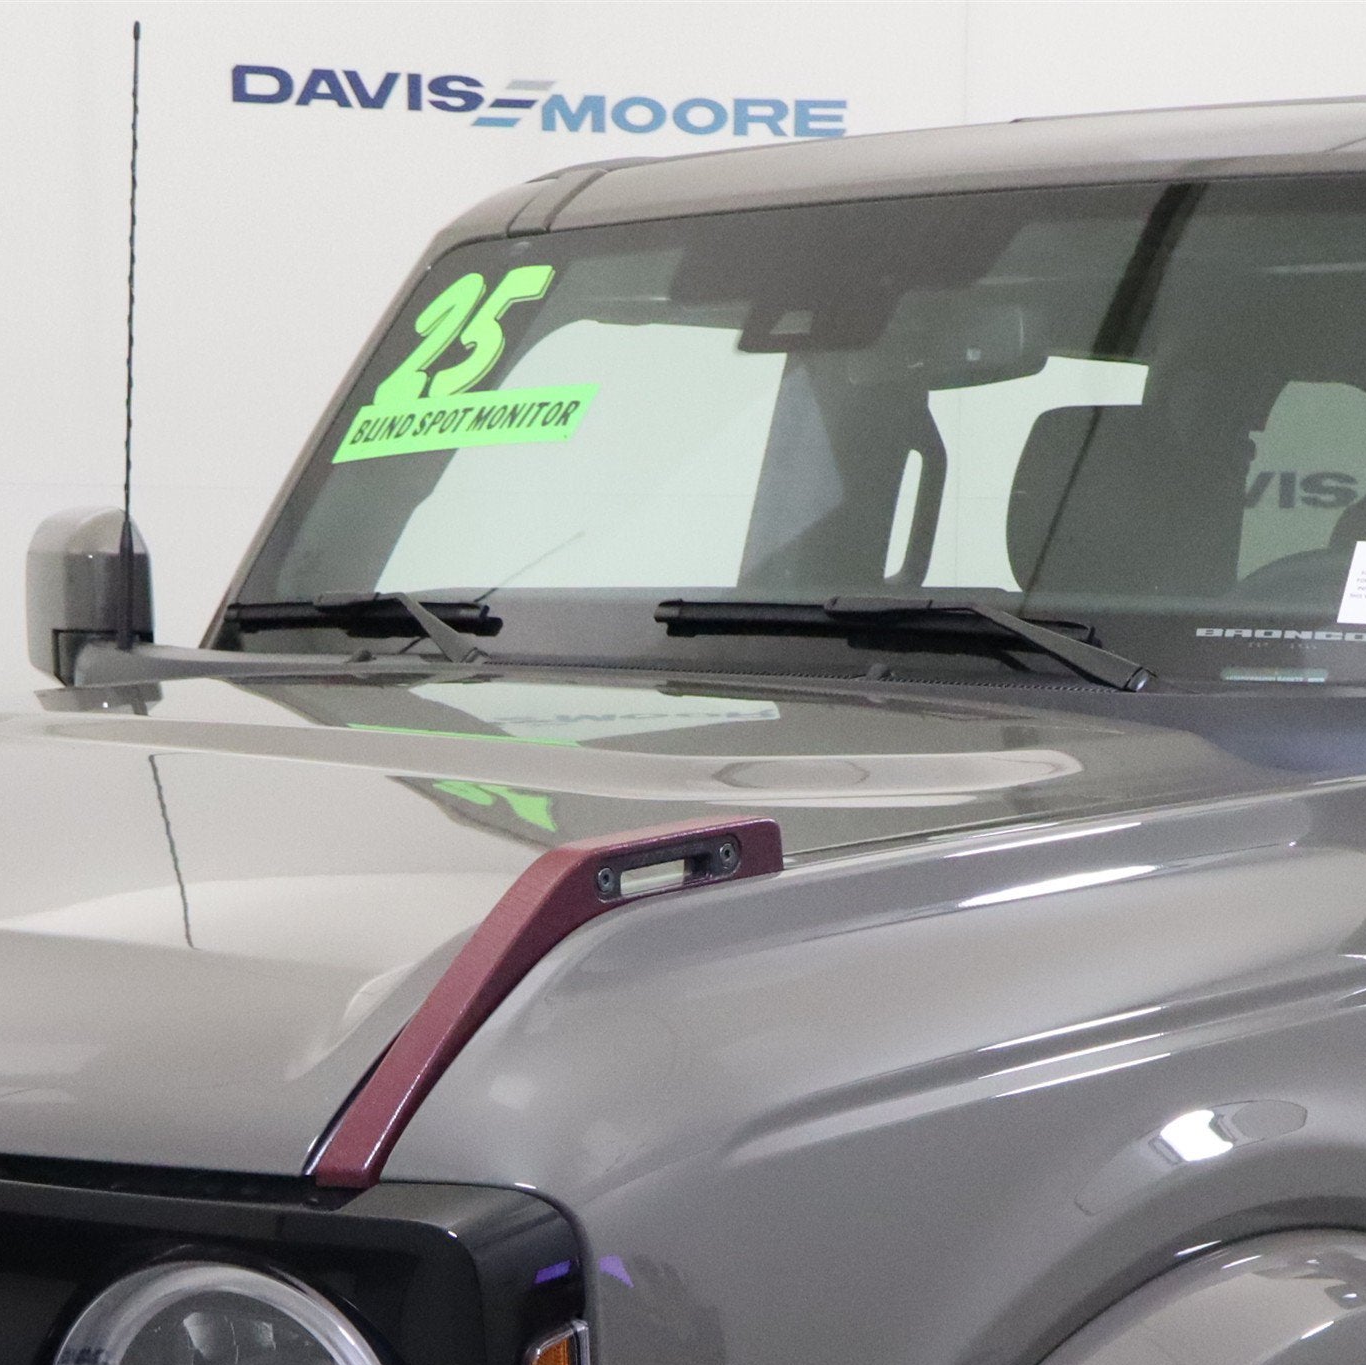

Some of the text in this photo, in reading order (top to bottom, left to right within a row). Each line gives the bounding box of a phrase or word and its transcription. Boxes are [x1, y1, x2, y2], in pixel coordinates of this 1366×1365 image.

[230, 64, 847, 139] DAVIS MOORE
[373, 265, 556, 406] 25
[349, 400, 581, 445] BLIND SPOT MONITOR
